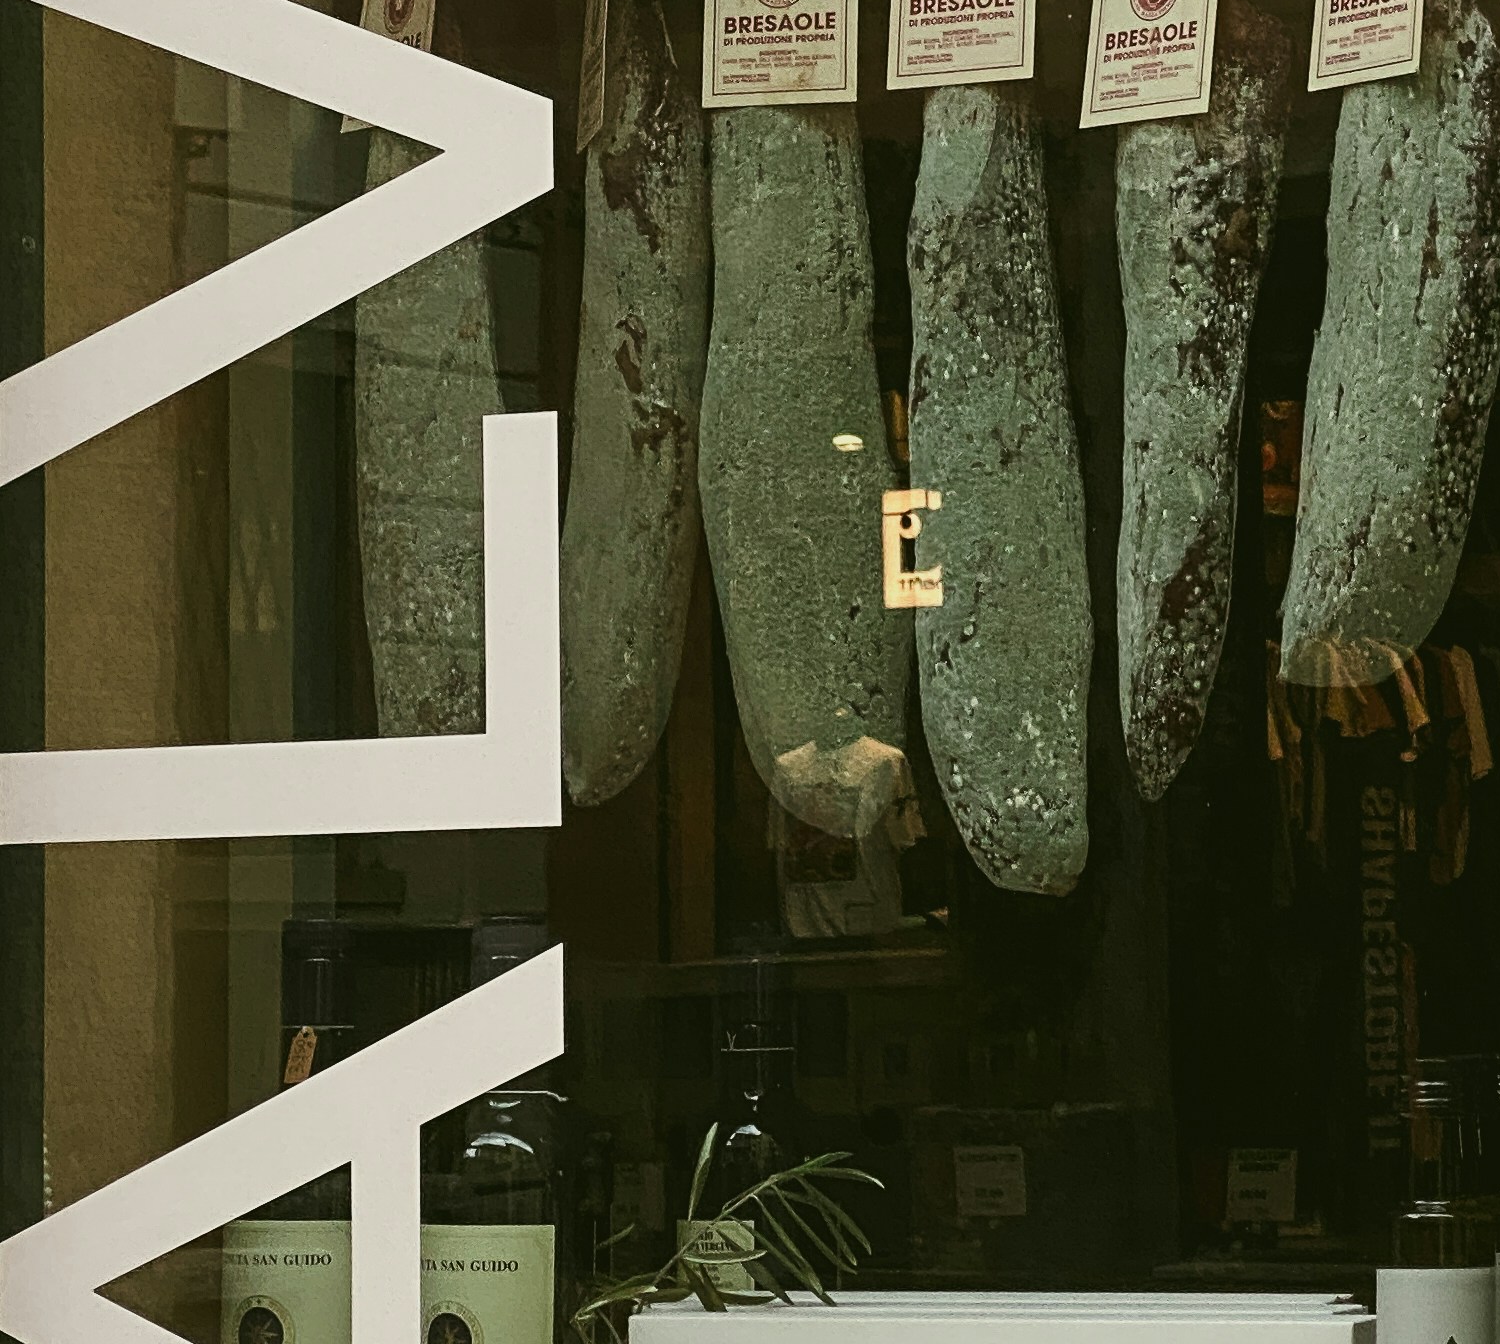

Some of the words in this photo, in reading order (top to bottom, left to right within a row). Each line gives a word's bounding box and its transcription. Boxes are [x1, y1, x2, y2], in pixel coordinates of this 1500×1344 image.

[724, 12, 836, 34] BRESAOLE
[724, 37, 733, 46] DI
[736, 34, 792, 45] PRODUZIONE
[795, 33, 835, 42] PROPRIA
[1105, 20, 1197, 51] BRESAOLE
[252, 1253, 278, 1265] SAN
[283, 1253, 332, 1266] GUIDO
[440, 1260, 465, 1271] SAN
[470, 1260, 519, 1272] GUIDO
